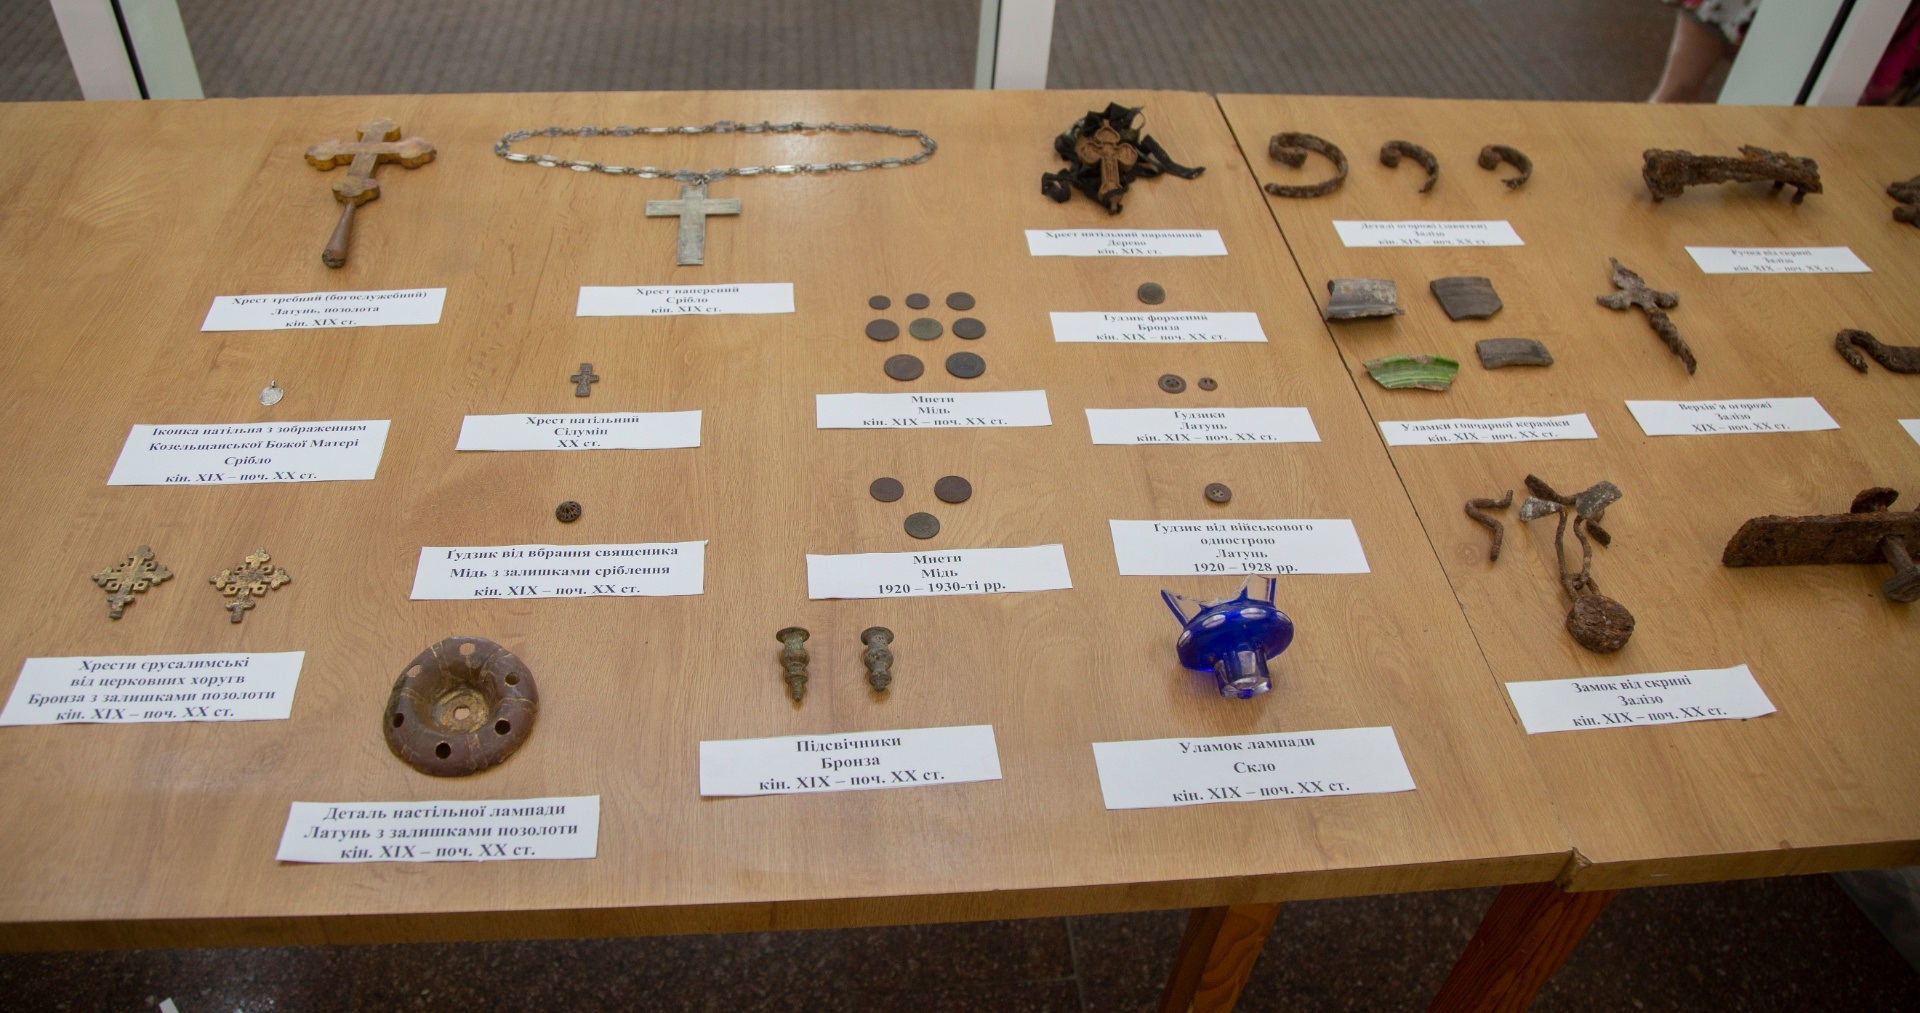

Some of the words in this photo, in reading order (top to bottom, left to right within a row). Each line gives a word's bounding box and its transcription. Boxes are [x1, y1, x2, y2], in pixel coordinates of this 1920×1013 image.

[272, 294, 322, 304] требний
[325, 291, 427, 302] (богослужебний)
[636, 288, 670, 297] Хрест
[665, 296, 708, 305] Срібло
[918, 406, 951, 415] Мідь
[526, 416, 564, 427] Хрест
[569, 415, 639, 424] натільний
[863, 418, 888, 426] кін.
[892, 418, 918, 426] XIX
[965, 417, 986, 425] XX
[1179, 422, 1228, 432] Латунь
[1401, 423, 1451, 432] Уламки
[1454, 420, 1514, 430] гончарної
[1516, 419, 1570, 429] кераміки
[152, 428, 199, 436] Іконка
[202, 426, 263, 435] натільна
[276, 424, 367, 434] зображенням
[554, 427, 608, 438] Сілумін
[149, 440, 264, 451] Козельщанської
[265, 440, 308, 449] Божої
[309, 438, 359, 449] Матері
[557, 439, 579, 448] XX
[224, 455, 272, 467] Срібло
[165, 473, 191, 483] кін.
[195, 473, 224, 482] XIX
[273, 472, 296, 480] XX
[1205, 522, 1227, 532] від
[1230, 522, 1313, 532] військового
[1200, 537, 1276, 547] однострою
[446, 548, 498, 562] Ґудзик
[502, 549, 523, 559] від
[528, 548, 591, 560] вбрання
[595, 548, 678, 557] священика
[1216, 549, 1268, 560] Латунь
[450, 568, 487, 578] Мідь
[503, 568, 590, 577] залишками
[595, 566, 670, 578] сріблення
[921, 568, 958, 579] Мідь
[1194, 562, 1225, 573] 1920
[1242, 562, 1272, 572] 1928
[1277, 564, 1298, 574] рр.
[474, 586, 502, 596] кін.
[507, 586, 538, 596] XIX
[592, 585, 616, 594] XX
[878, 584, 911, 594] 1920
[928, 580, 979, 593] 1930-ті
[983, 582, 1006, 593] рр.
[79, 660, 137, 673] Хрести
[140, 656, 250, 673] єрусалимські
[70, 675, 95, 687] від
[98, 676, 185, 689] церковних
[190, 676, 245, 687] хоругв
[1571, 682, 1618, 693] Замок
[1619, 679, 1643, 690] від
[1644, 674, 1692, 690] скрині
[28, 693, 86, 708] Бронза
[89, 694, 98, 703] з
[101, 693, 197, 703] залишками
[201, 691, 276, 701] позолоти
[1617, 694, 1664, 707] Залізо
[56, 709, 85, 721] кін.
[91, 708, 126, 720] XIX
[143, 710, 177, 719] поч.
[182, 706, 209, 718] XX
[213, 708, 234, 717] ст.
[1572, 715, 1601, 727] кін.
[1602, 712, 1634, 724] XIX
[1648, 711, 1679, 721] поч.
[1682, 706, 1706, 718] XX
[1707, 708, 1727, 716] ст.
[796, 737, 901, 753] Підсвічники
[1178, 742, 1243, 754] Уламок
[1247, 737, 1316, 750] лампади
[821, 756, 880, 772] Бронза
[1233, 761, 1276, 774] Скло
[759, 778, 791, 791] кін.
[796, 775, 830, 789] XIX
[850, 775, 886, 786] поч.
[890, 769, 918, 783] XX
[922, 771, 945, 781] ст.
[1172, 790, 1204, 802] кін.
[1207, 786, 1242, 800] XIX
[1260, 784, 1294, 796] поч.
[1298, 781, 1324, 794] XX
[1329, 783, 1350, 792] ст.
[323, 807, 387, 821] Деталь
[393, 805, 486, 819] настільної
[489, 804, 566, 818] лампади
[303, 826, 371, 842] Латунь
[376, 829, 385, 838] з
[390, 827, 492, 838] залишками
[498, 825, 578, 837] позолоти
[340, 845, 373, 859] кін.
[379, 845, 416, 858] XIX
[436, 847, 473, 857] поч.
[479, 843, 507, 857] XX
[513, 846, 535, 856] ст.
